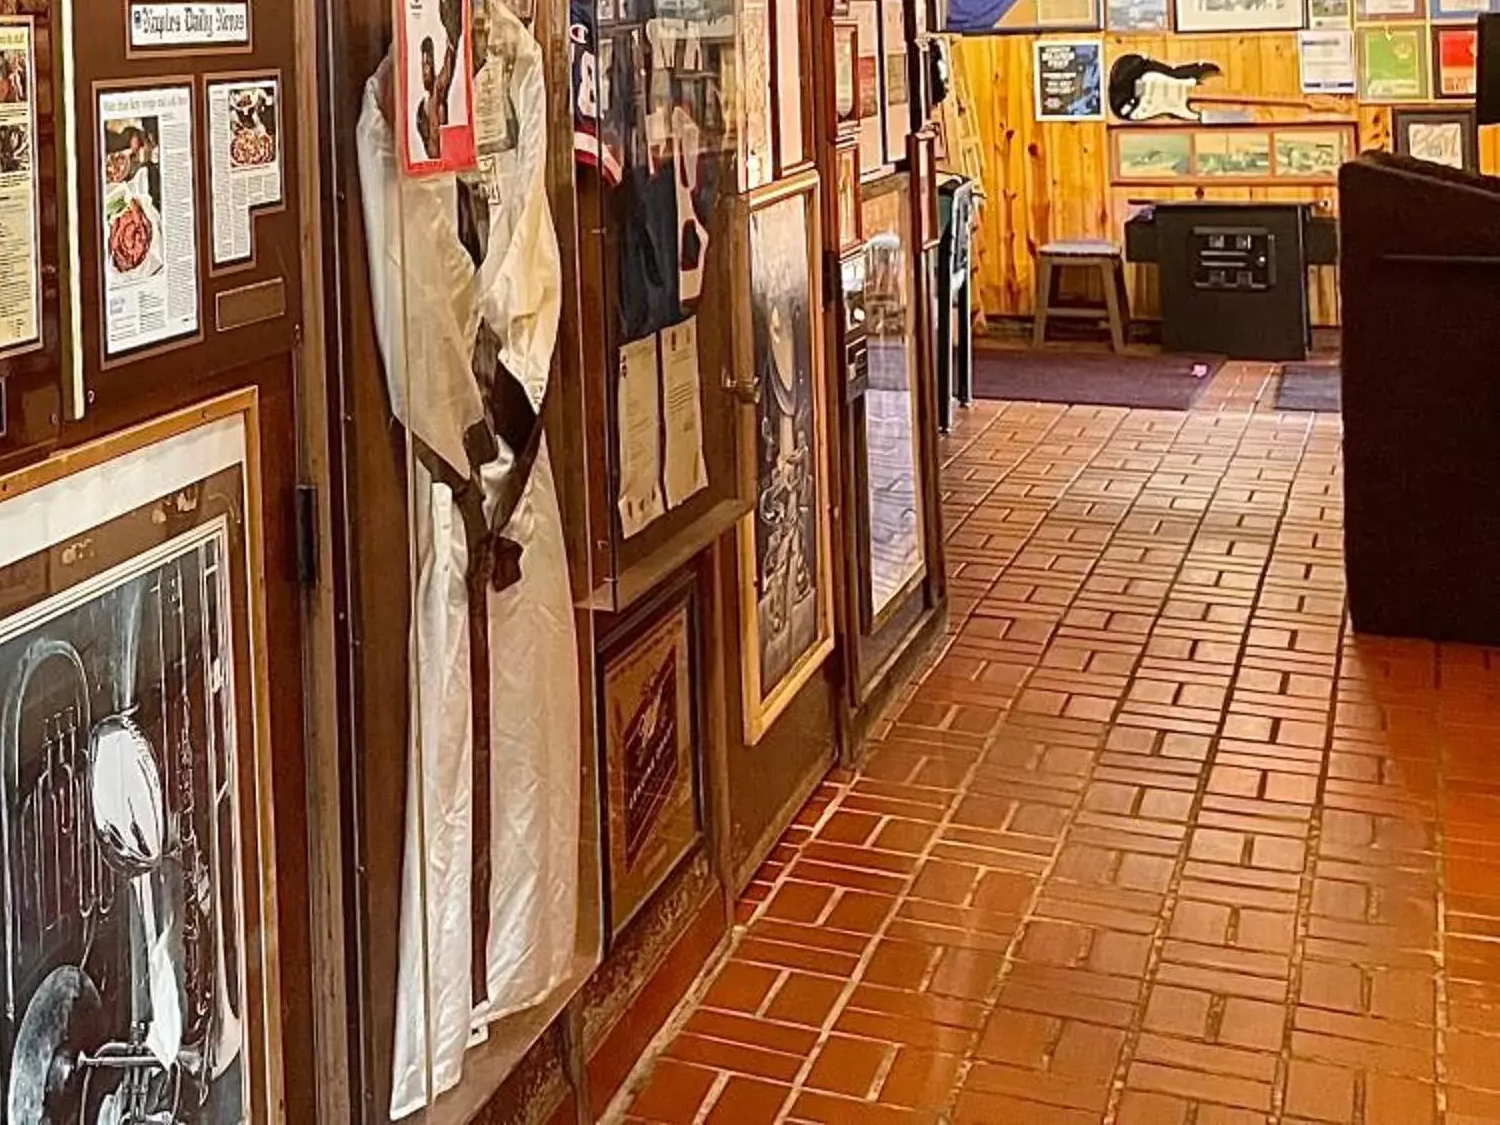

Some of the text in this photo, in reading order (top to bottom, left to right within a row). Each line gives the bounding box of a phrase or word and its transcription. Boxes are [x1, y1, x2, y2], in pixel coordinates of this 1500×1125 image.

[142, 7, 244, 38] Naples Daily News
